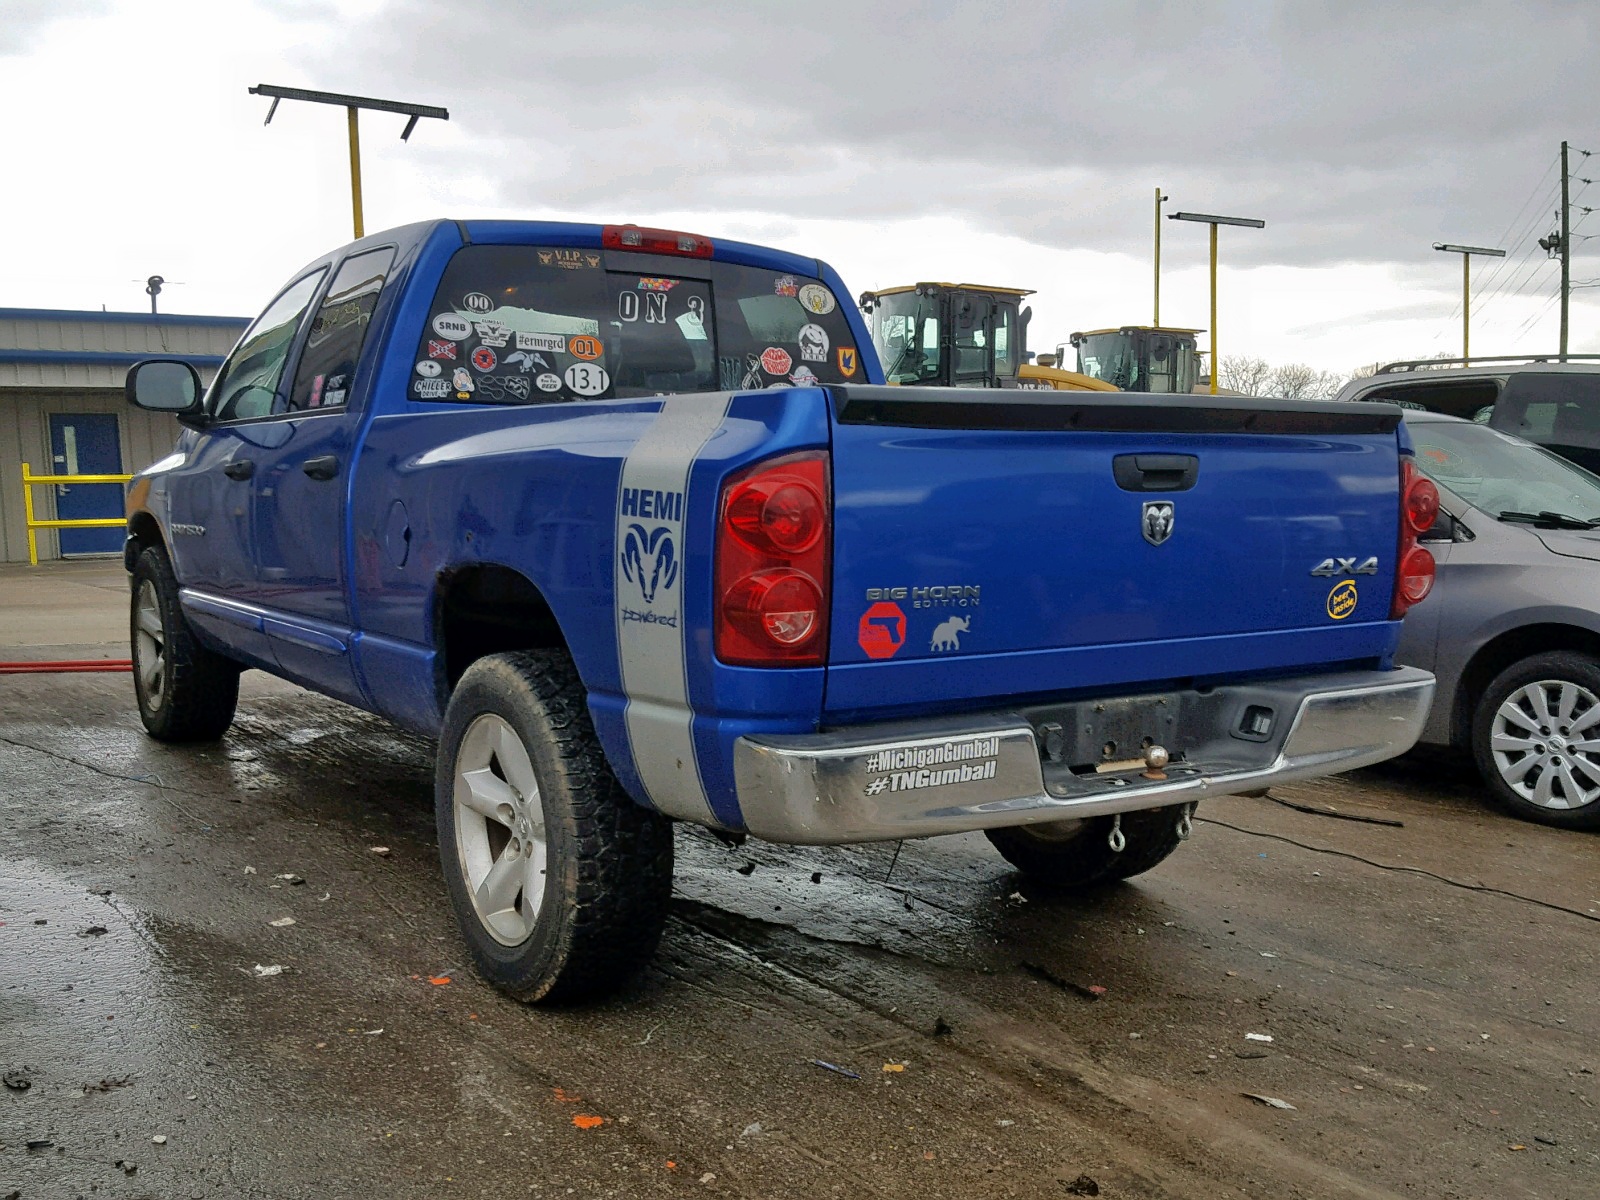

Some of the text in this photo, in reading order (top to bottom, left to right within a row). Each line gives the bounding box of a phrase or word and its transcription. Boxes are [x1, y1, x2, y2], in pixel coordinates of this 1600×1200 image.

[468, 295, 488, 310] 00
[439, 321, 467, 332] SRNB
[518, 334, 564, 351] #ermrgrd
[575, 339, 597, 356] 01
[415, 380, 452, 392] CHILLER
[570, 367, 605, 391] 13.1
[621, 487, 682, 522] HEMI
[866, 585, 980, 601] BIG HORN
[913, 598, 980, 609] EDITION
[865, 737, 1000, 773] #MichiganGumball
[864, 760, 998, 797] #TNGumball
